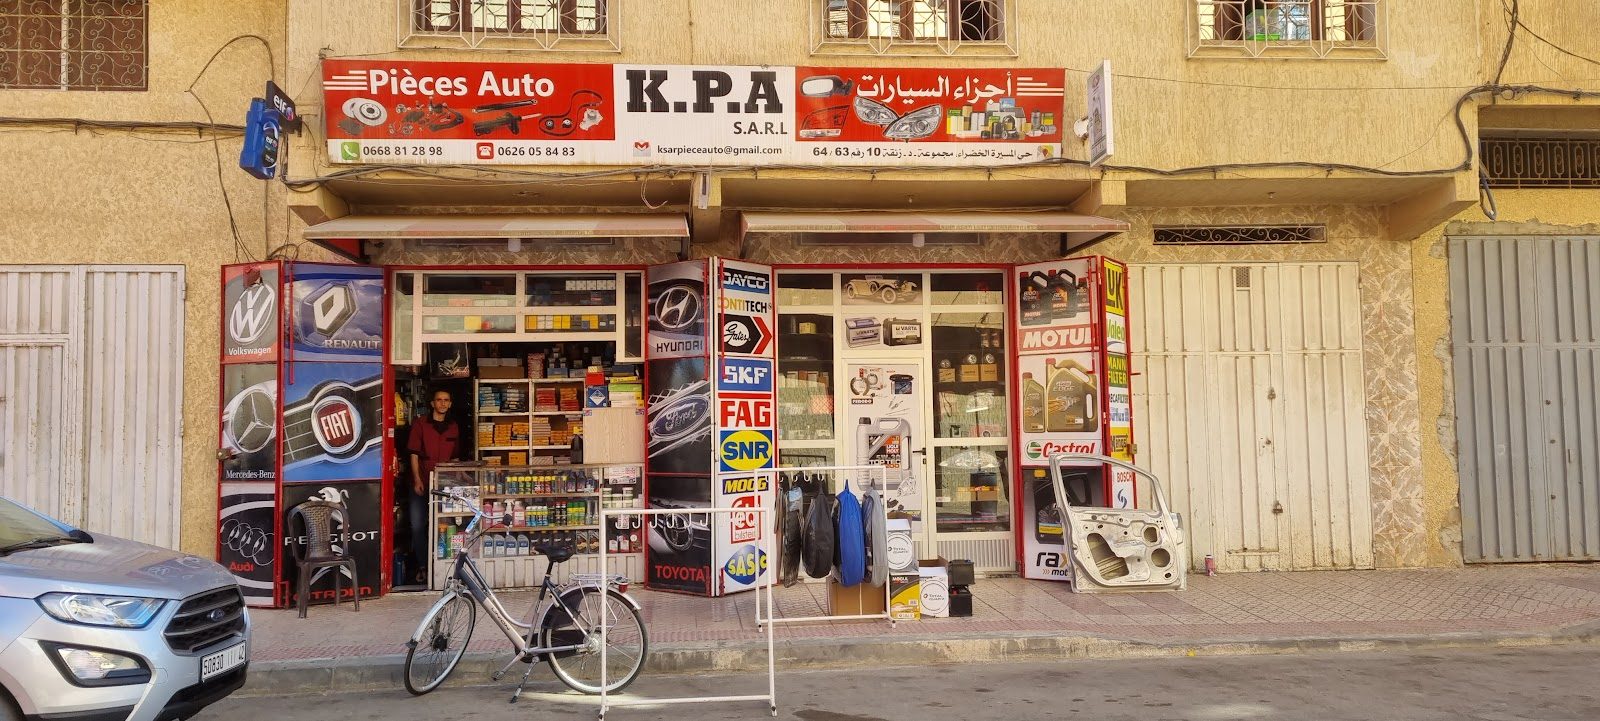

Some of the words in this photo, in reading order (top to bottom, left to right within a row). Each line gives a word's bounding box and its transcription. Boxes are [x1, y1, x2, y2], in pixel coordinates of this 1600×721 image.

[369, 68, 468, 97] Pièces
[478, 71, 555, 97] Auto
[954, 71, 1012, 105] أجزاء
[626, 69, 783, 113] K.P.A
[857, 74, 949, 105] السيارات
[273, 94, 287, 113] elf
[733, 121, 788, 135] S.A.R.L
[363, 146, 391, 156] 0668
[394, 146, 408, 156] 81
[412, 146, 426, 156] 28
[429, 146, 443, 156] 98
[498, 146, 525, 156] 0626
[528, 146, 542, 156] 05
[545, 146, 559, 156] 84
[562, 146, 575, 156] 83
[657, 145, 783, 156] ksarpieceauto@gmail.com
[812, 147, 828, 157] 64
[834, 147, 850, 157] 63
[850, 148, 865, 159] رقم
[866, 147, 881, 157] 10
[882, 148, 902, 159] زنقة
[918, 149, 954, 160] مجموعة
[991, 149, 1016, 160] المسيرة
[228, 346, 272, 356] Volkswagen
[323, 339, 380, 350] RENAULT
[656, 340, 703, 353] HYUNDAI
[723, 366, 768, 384] SKF
[720, 401, 771, 427] FAG
[320, 410, 351, 441] FIAT
[723, 441, 769, 460] SNR
[1043, 442, 1095, 458] Castrol
[226, 469, 276, 479] Mercedes-Benz
[284, 531, 379, 546] PEGEOT
[229, 562, 254, 572] Audi
[728, 553, 767, 577] SASC
[655, 565, 706, 581] TOYOTA
